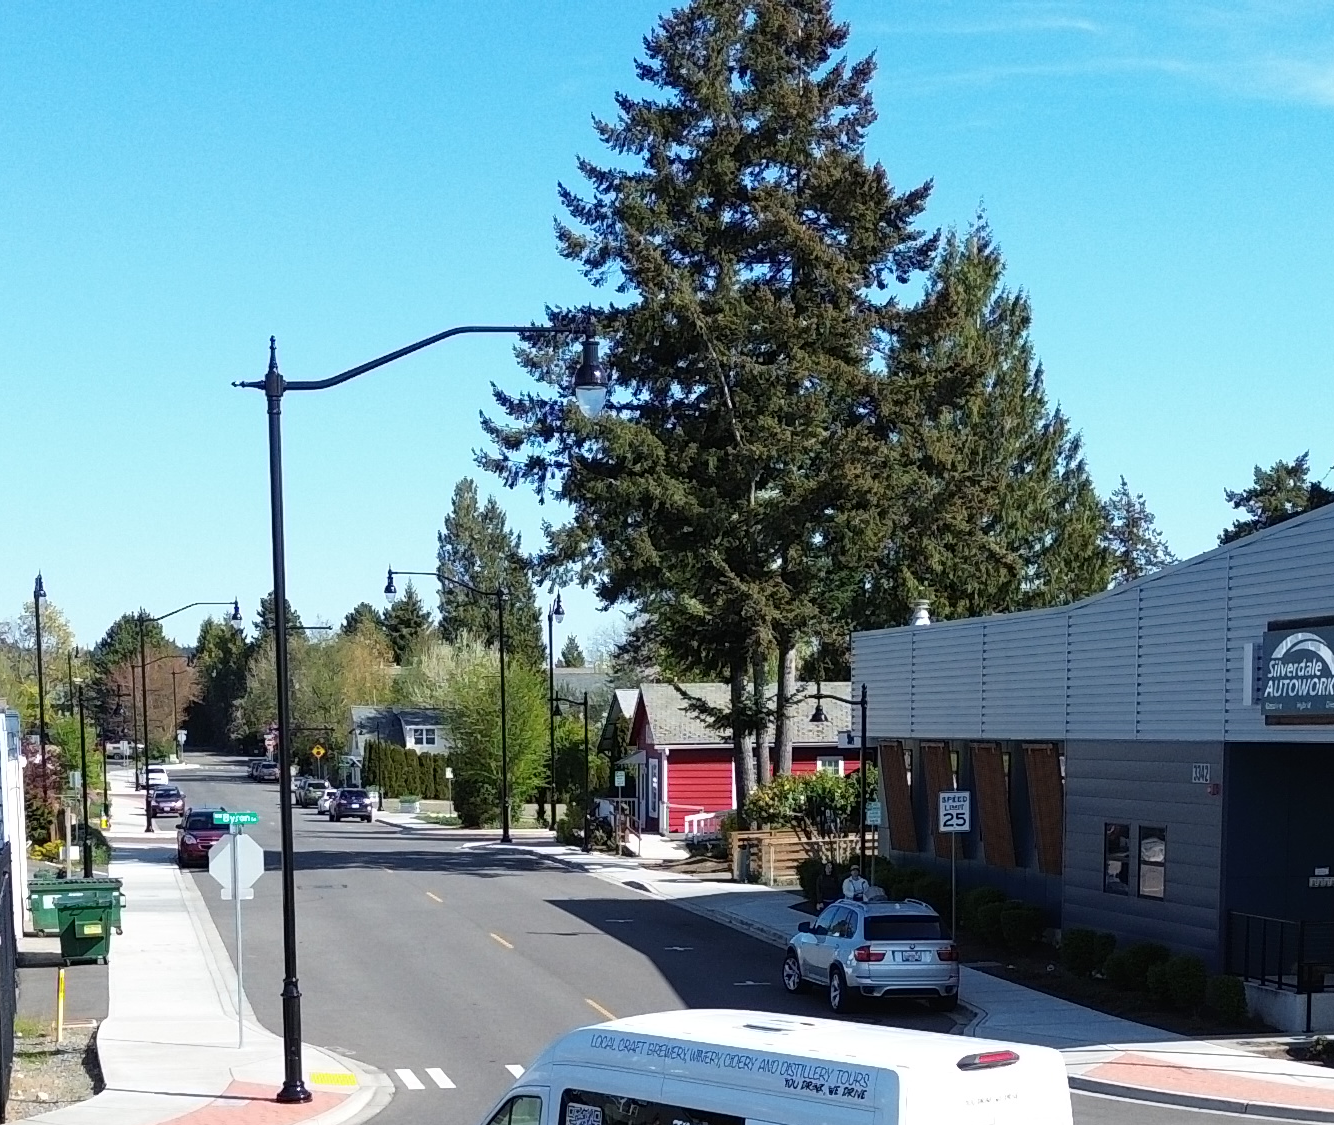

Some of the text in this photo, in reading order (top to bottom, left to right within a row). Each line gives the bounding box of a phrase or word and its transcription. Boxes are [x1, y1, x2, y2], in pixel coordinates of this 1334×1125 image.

[1267, 658, 1322, 677] Silverdale
[943, 812, 967, 827] 25
[590, 1033, 616, 1051] LOCAL
[617, 1038, 647, 1054] CRAFT
[723, 1052, 758, 1071] CIDERY
[758, 1058, 779, 1074] AND
[780, 1061, 834, 1082] DISTILLERY
[836, 1069, 870, 1088] TOURS
[784, 1077, 800, 1089] YOU
[828, 1085, 840, 1096] WE
[841, 1086, 868, 1100] DRIVE
